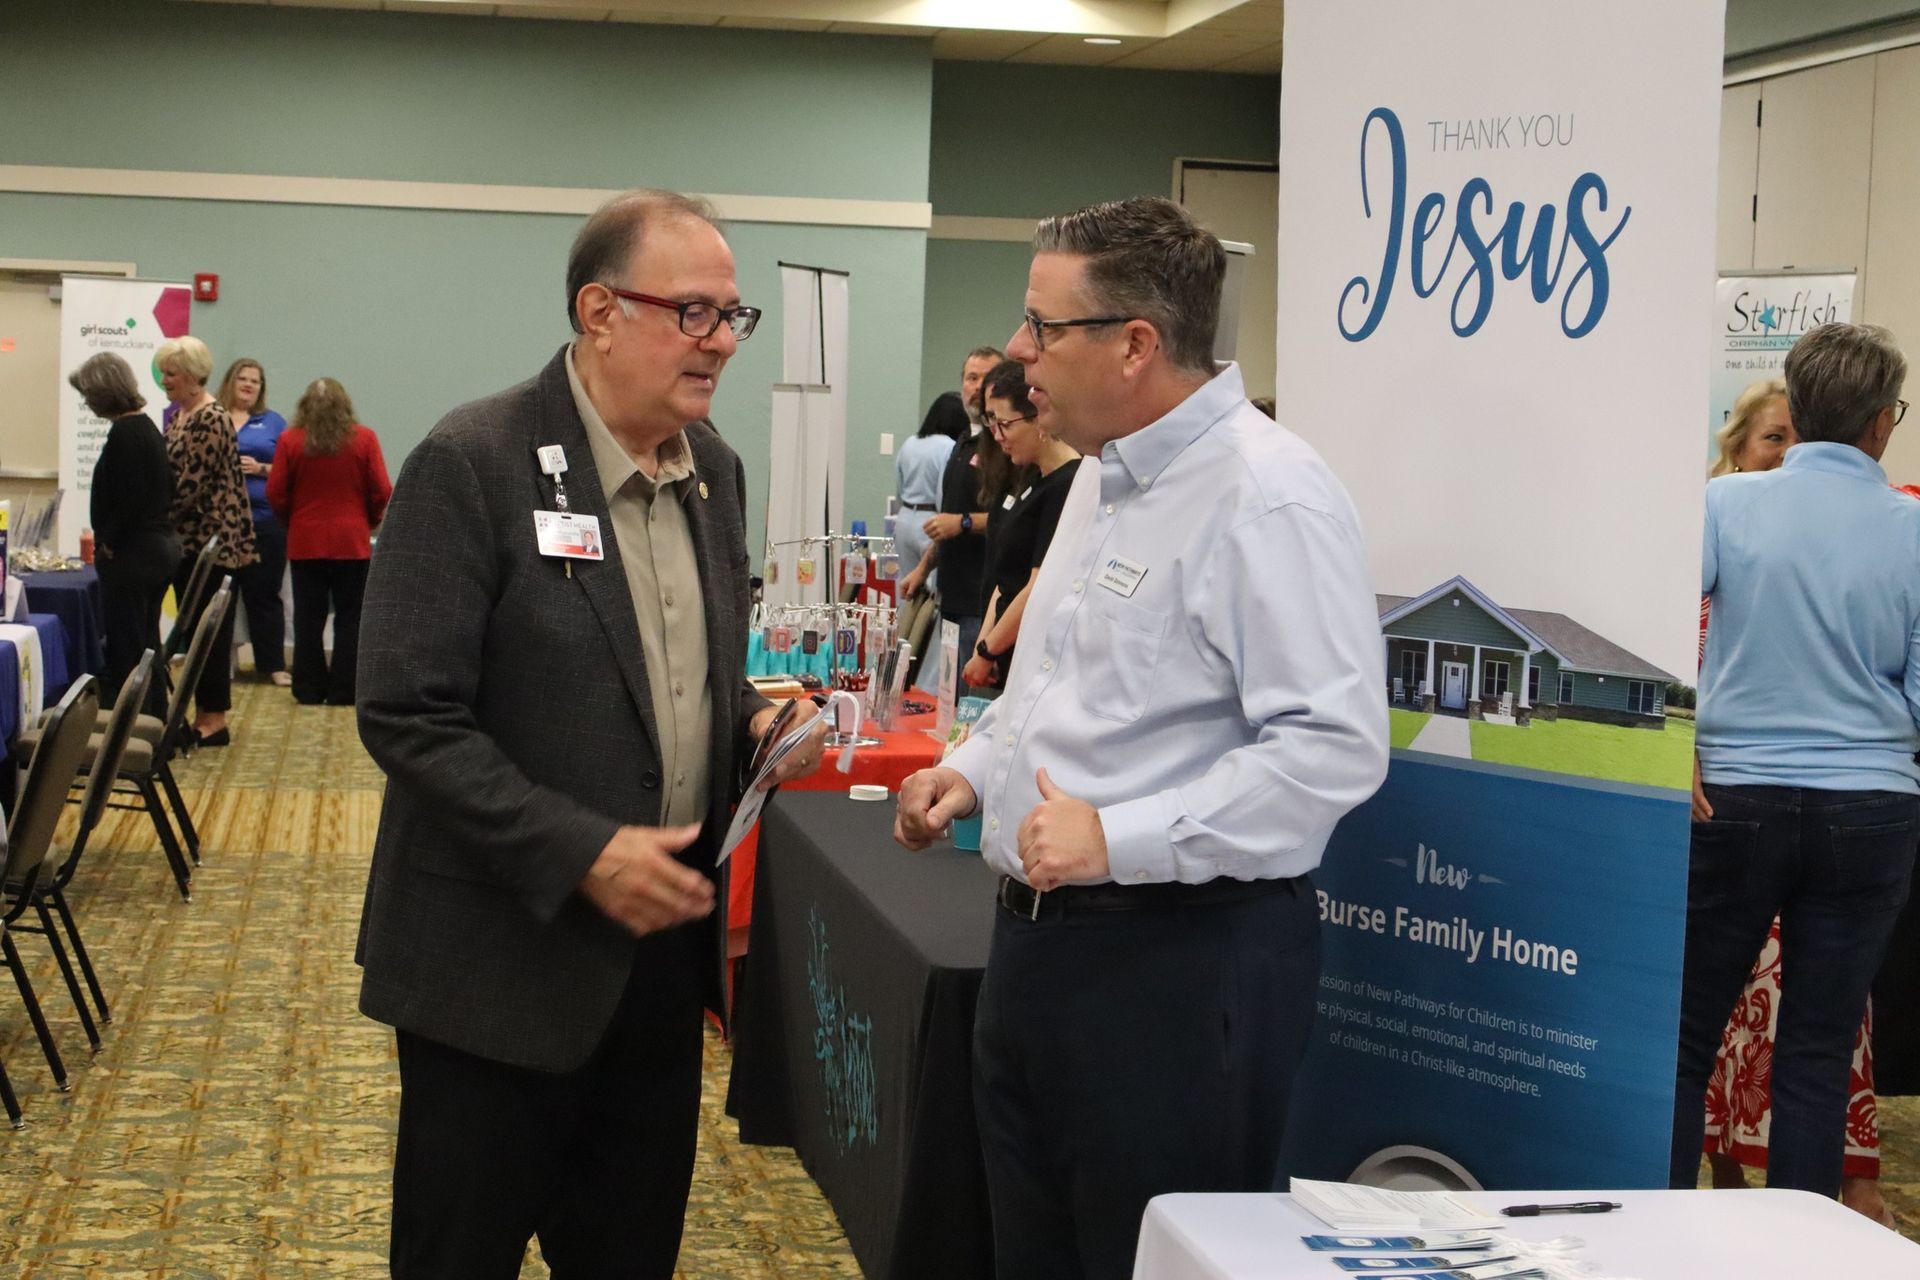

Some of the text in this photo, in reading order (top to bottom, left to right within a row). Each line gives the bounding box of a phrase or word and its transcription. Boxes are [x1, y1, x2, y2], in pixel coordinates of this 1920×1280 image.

[1428, 113, 1574, 152] THANK YOU
[1337, 106, 1632, 342] Jesus
[80, 324, 129, 336] girl scouts
[88, 337, 155, 349] of kentuckiana
[1729, 340, 1777, 349] ORPHAN
[1416, 843, 1473, 890] New
[1315, 889, 1578, 976] Burse Family Home
[1319, 973, 1599, 1051] ission of New Pathways for Children is to minister
[1328, 1001, 1373, 1028] physical,
[1375, 1015, 1409, 1037] social,
[1411, 1025, 1470, 1053] emotional,
[1472, 1040, 1496, 1057] and
[1498, 1045, 1546, 1069] spiritual
[1548, 1059, 1587, 1079] needs
[1330, 1031, 1542, 1097] of children in a Christ-like atmosphere.
